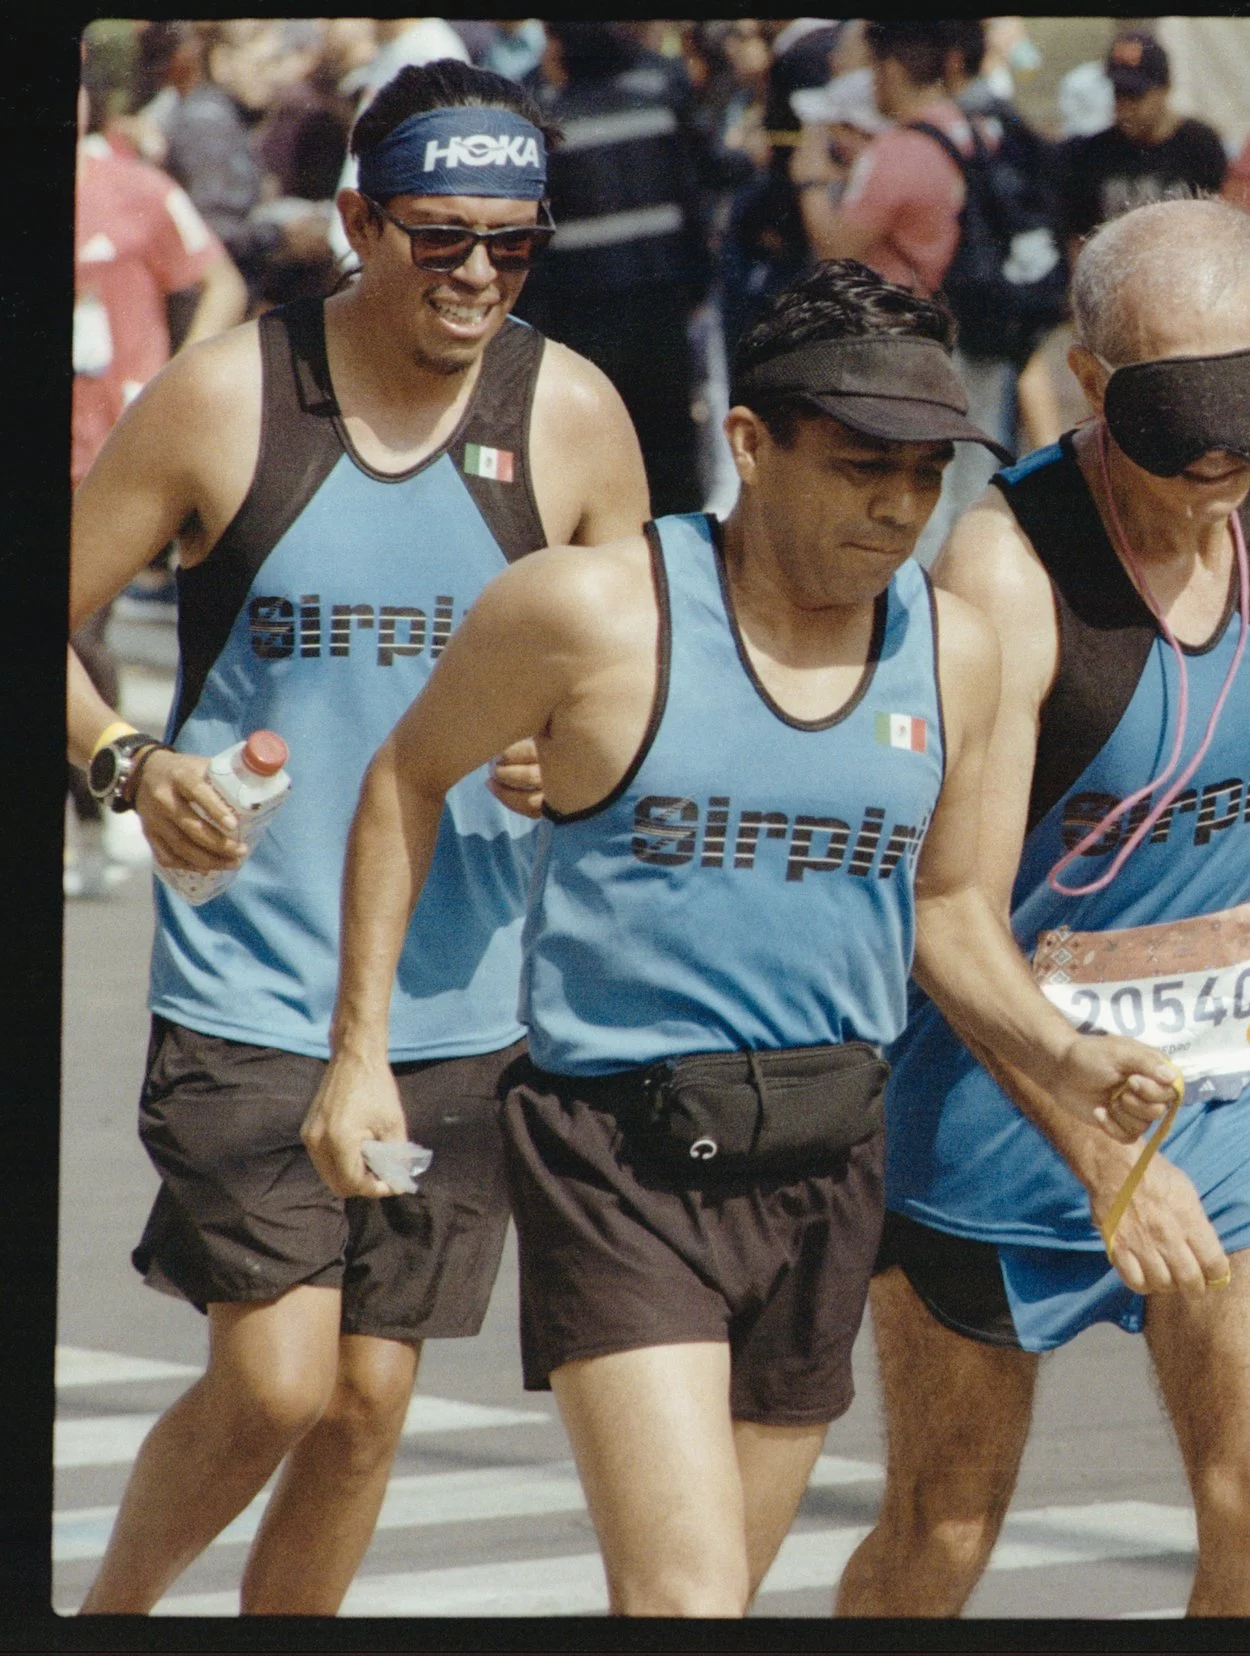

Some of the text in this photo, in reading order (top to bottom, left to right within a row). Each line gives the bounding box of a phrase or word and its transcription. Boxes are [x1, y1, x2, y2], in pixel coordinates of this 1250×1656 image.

[423, 134, 540, 172] HOKA
[250, 594, 467, 666] Sirpi
[1160, 1042, 1192, 1055] EDRO
